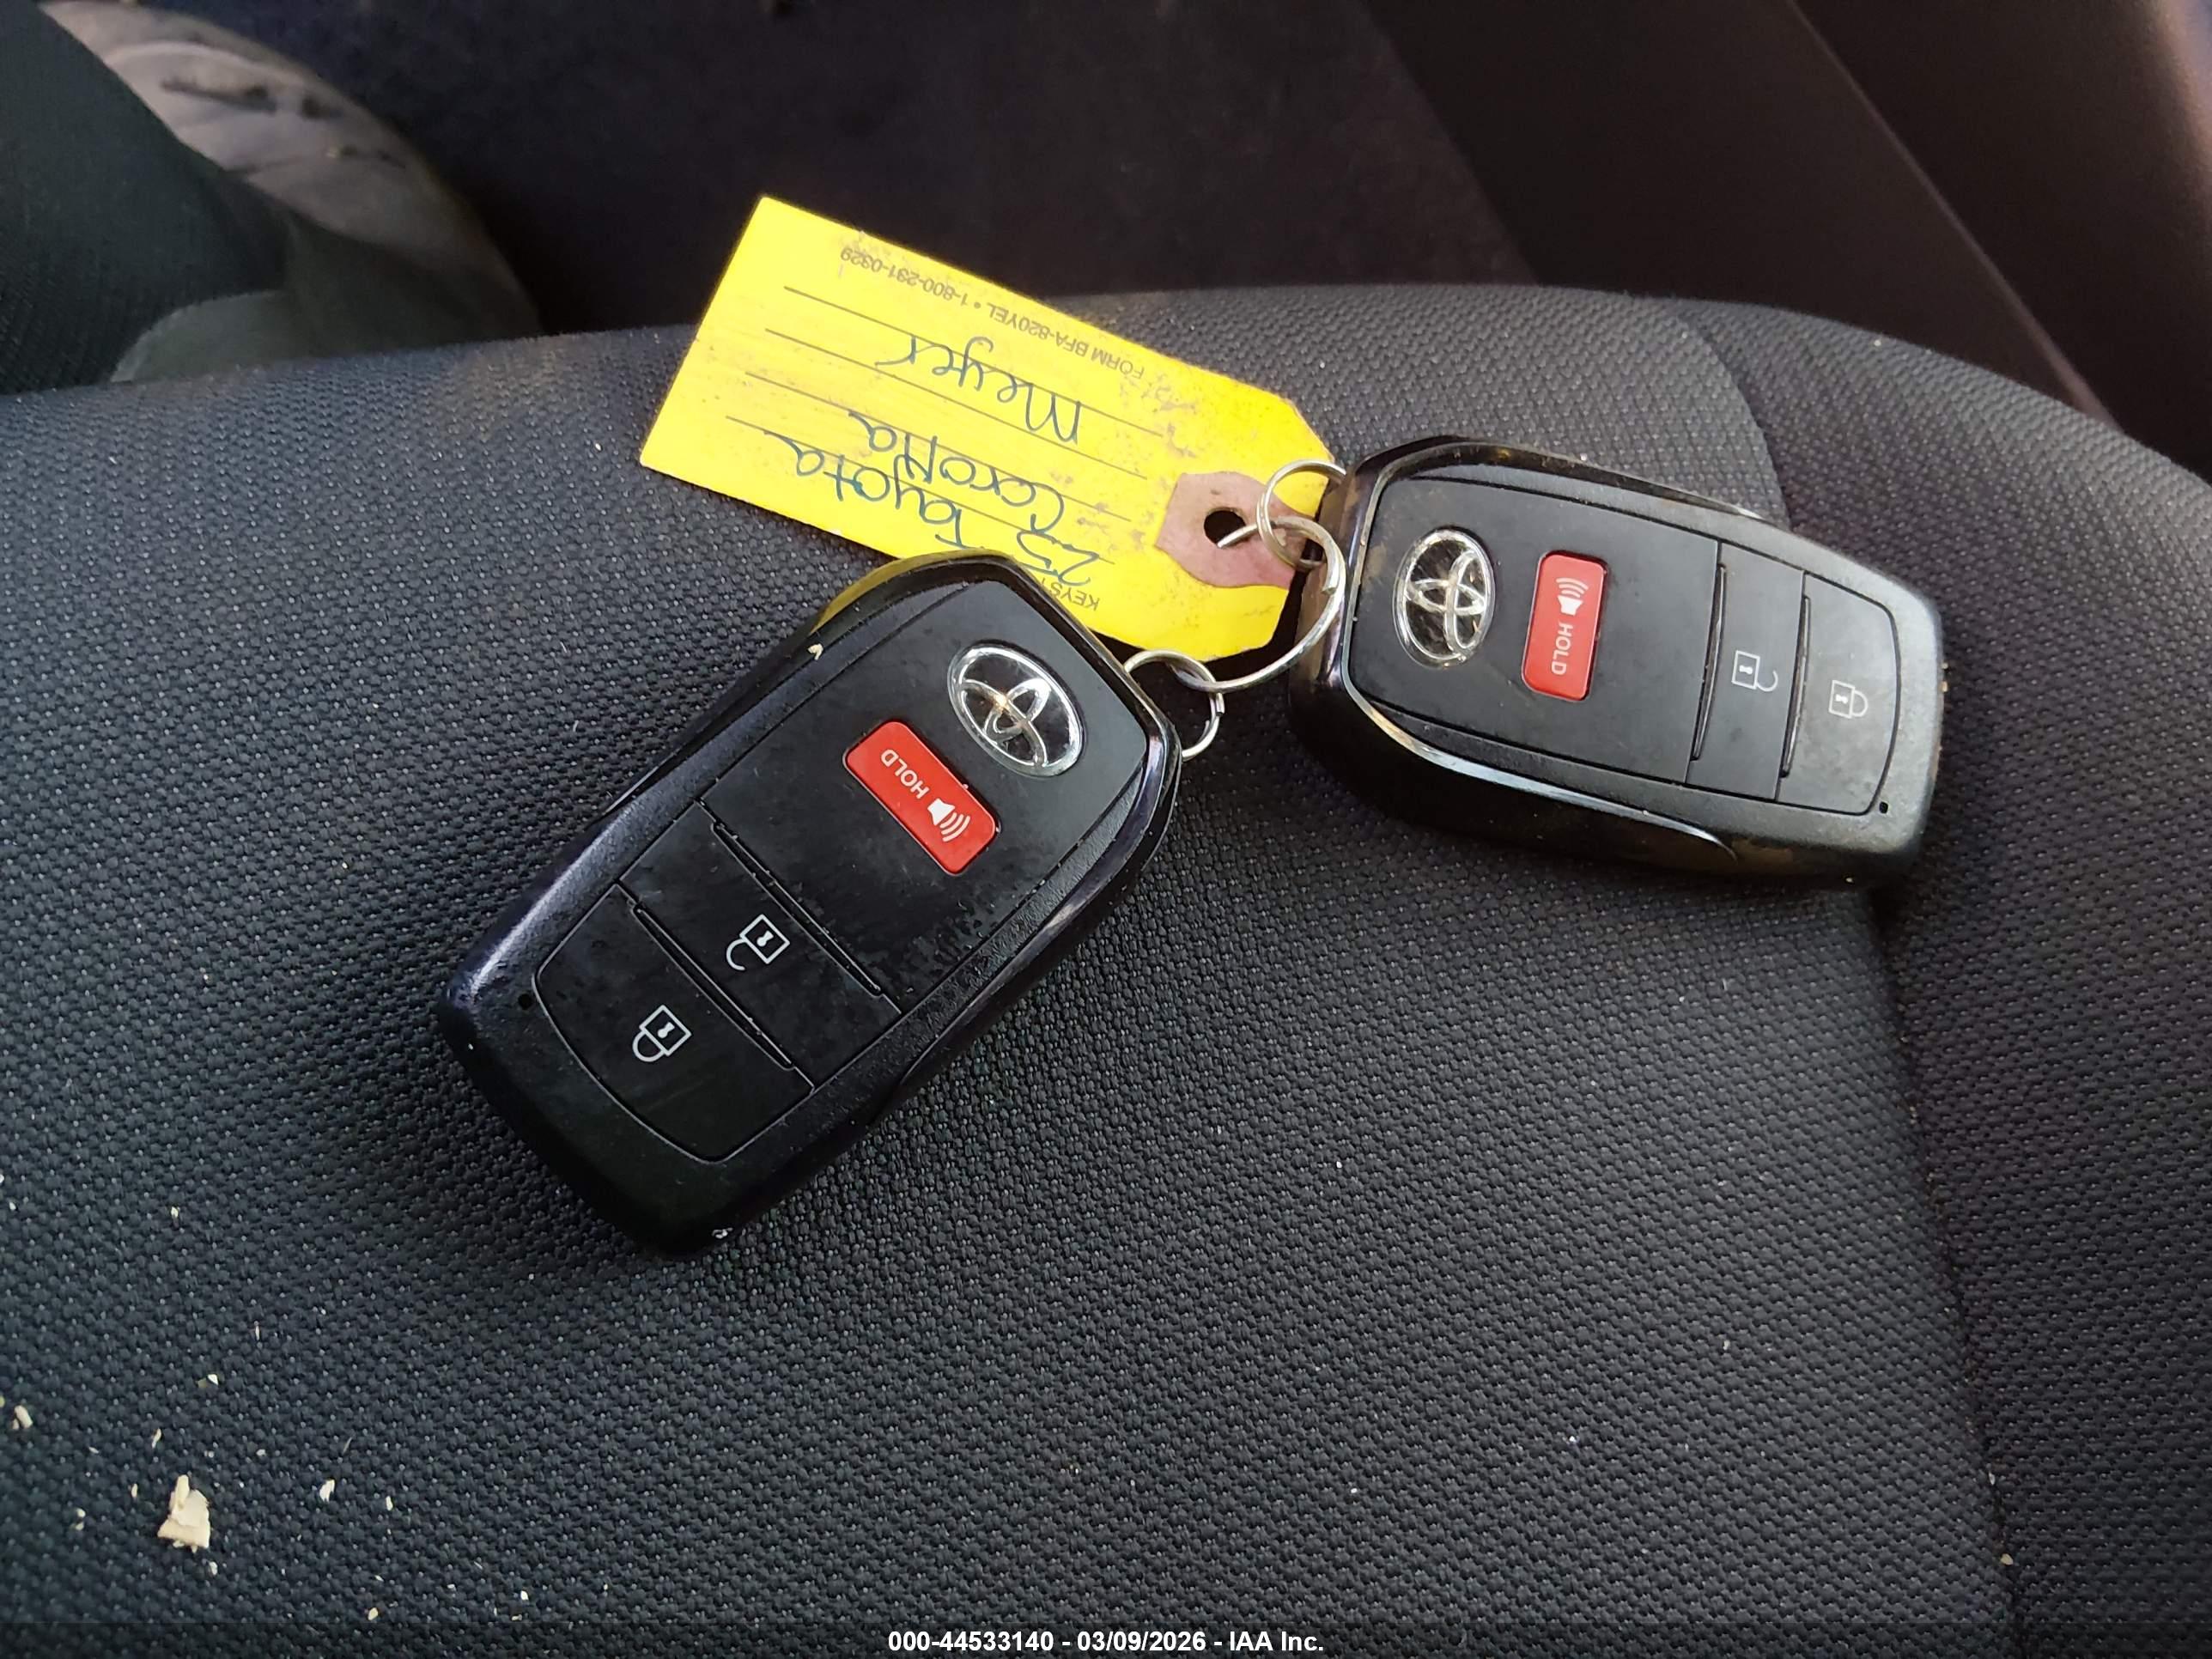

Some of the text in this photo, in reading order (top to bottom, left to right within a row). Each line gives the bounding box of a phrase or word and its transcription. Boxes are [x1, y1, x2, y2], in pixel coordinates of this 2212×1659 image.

[840, 246, 1146, 380] FORM BFA-820YEL 1-800-231-0329
[874, 336, 1082, 444] Meyer
[763, 430, 1100, 586] 25 Toyota
[848, 410, 1065, 533] Corolla
[1041, 577, 1100, 611] KEYS
[1551, 621, 1573, 675] HOLD
[880, 749, 930, 799] HOLD
